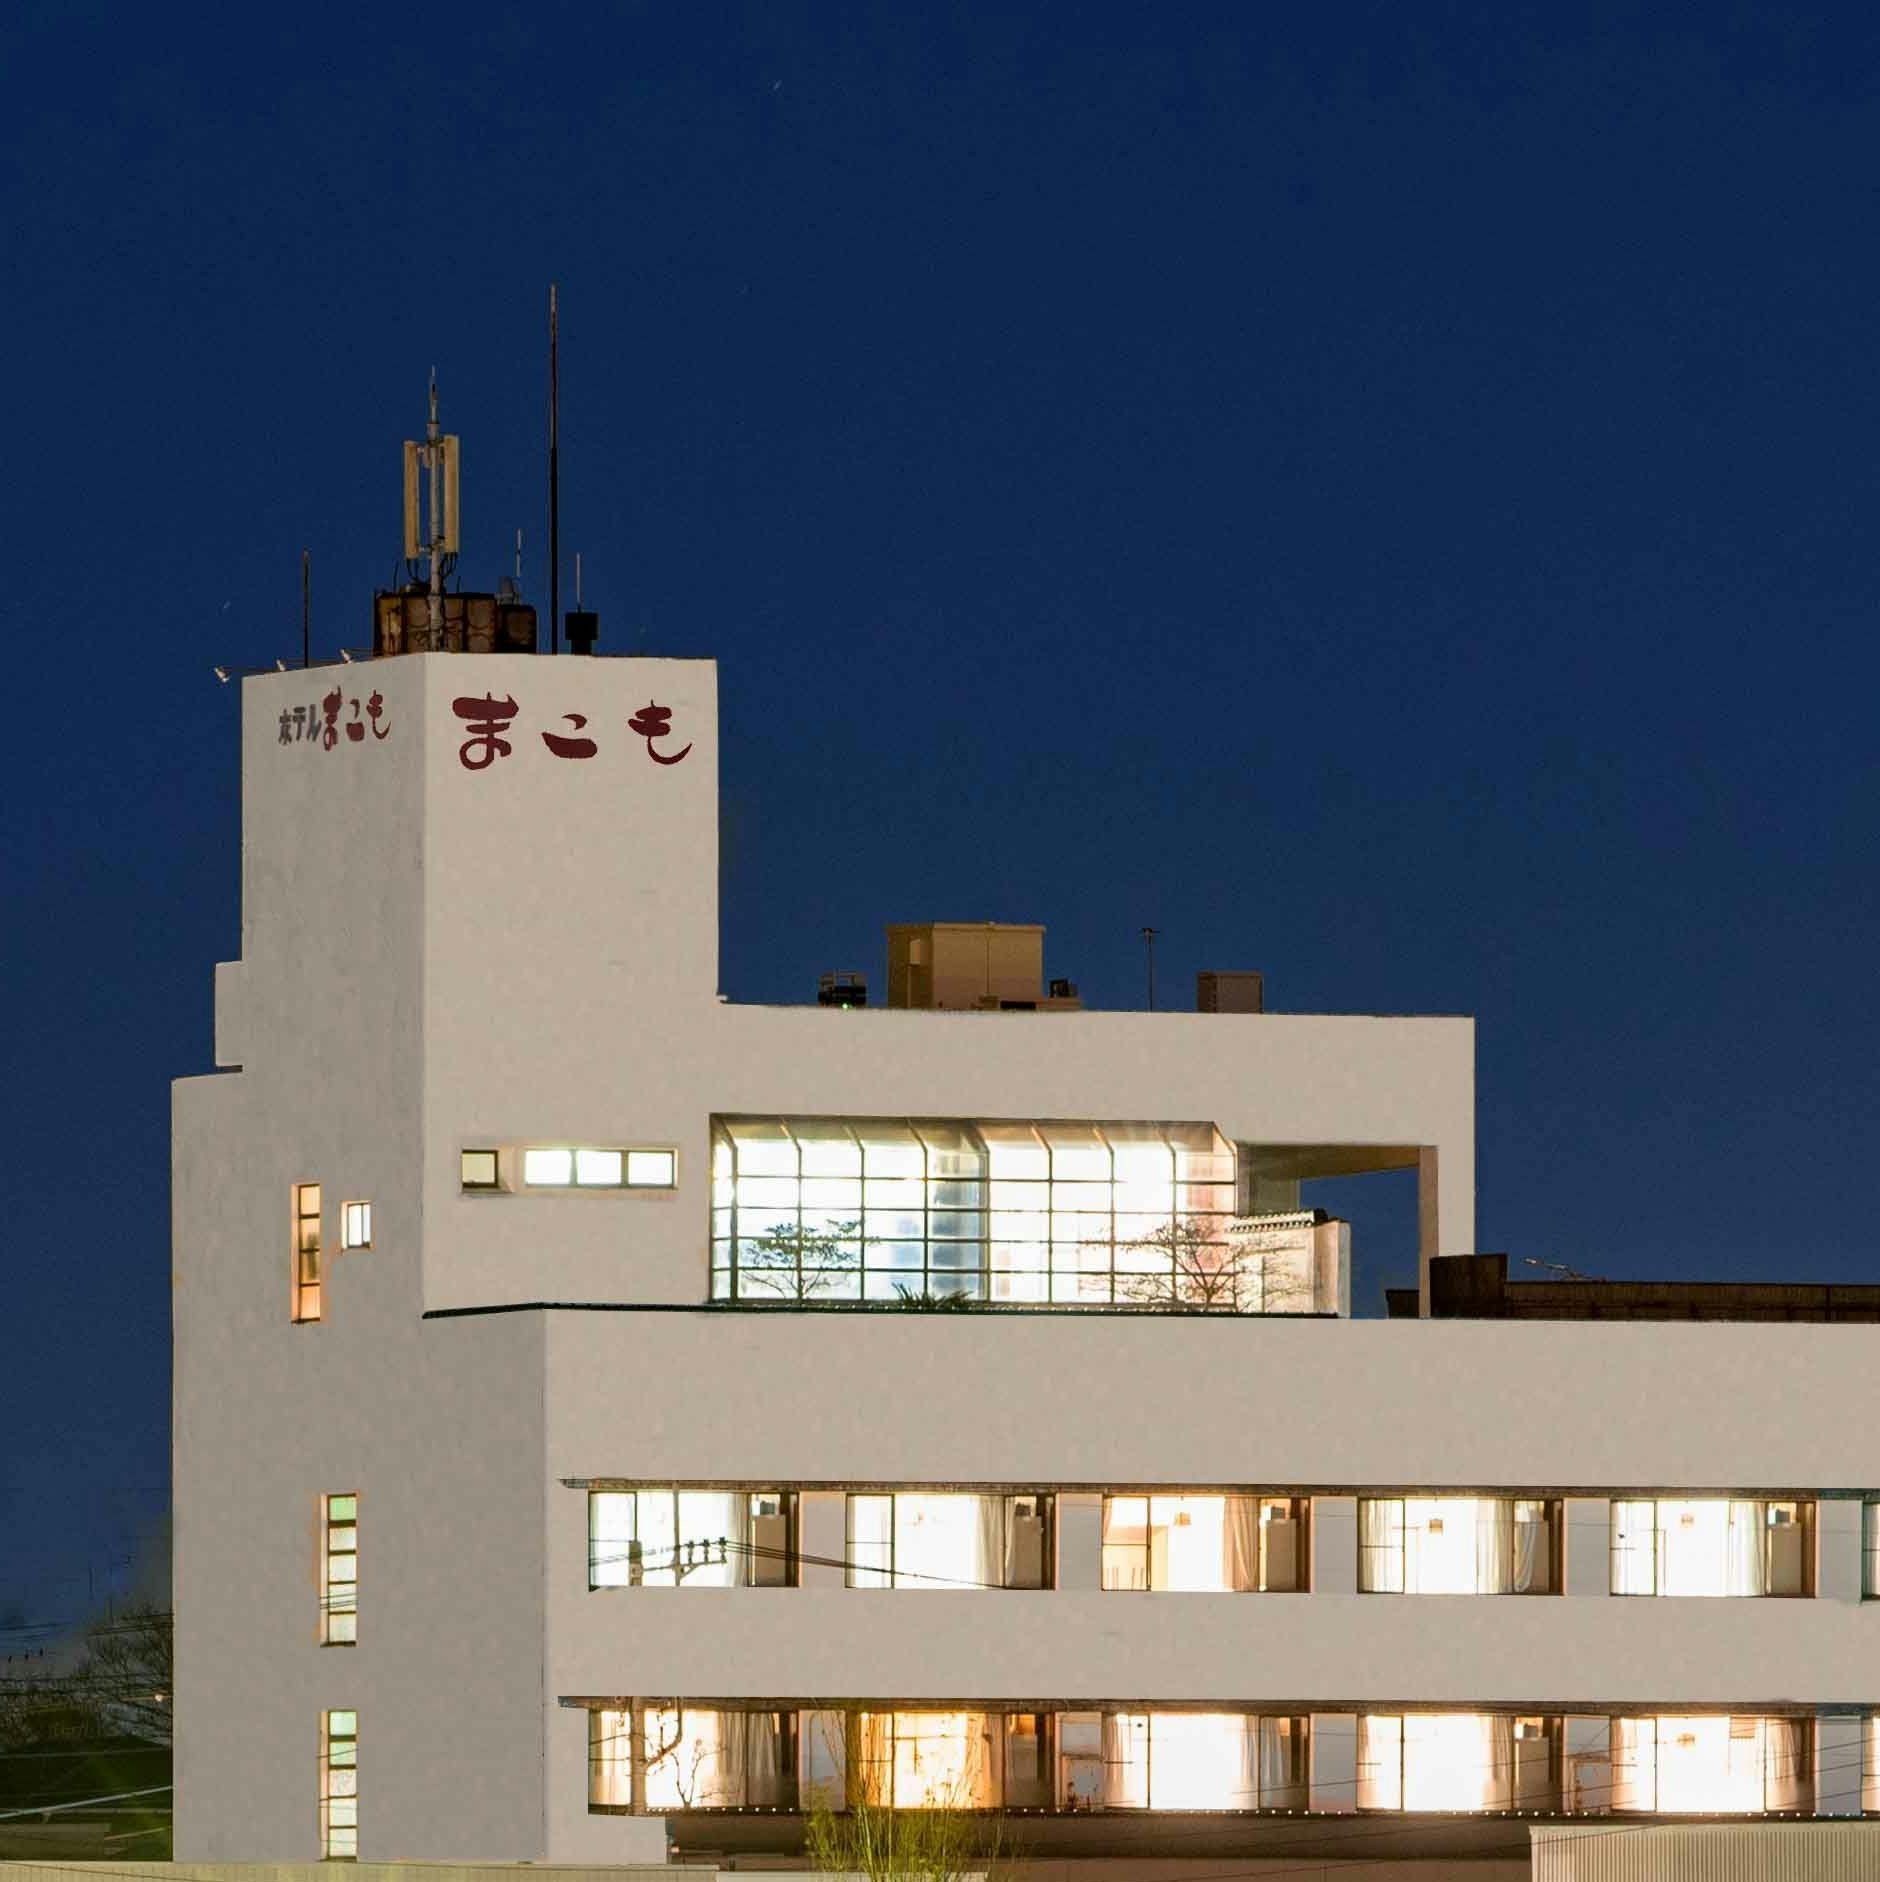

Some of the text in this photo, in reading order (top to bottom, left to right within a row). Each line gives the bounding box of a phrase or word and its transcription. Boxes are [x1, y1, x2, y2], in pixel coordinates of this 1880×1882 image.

[278, 685, 392, 751] ホテルまこも
[452, 691, 692, 770] まこも
